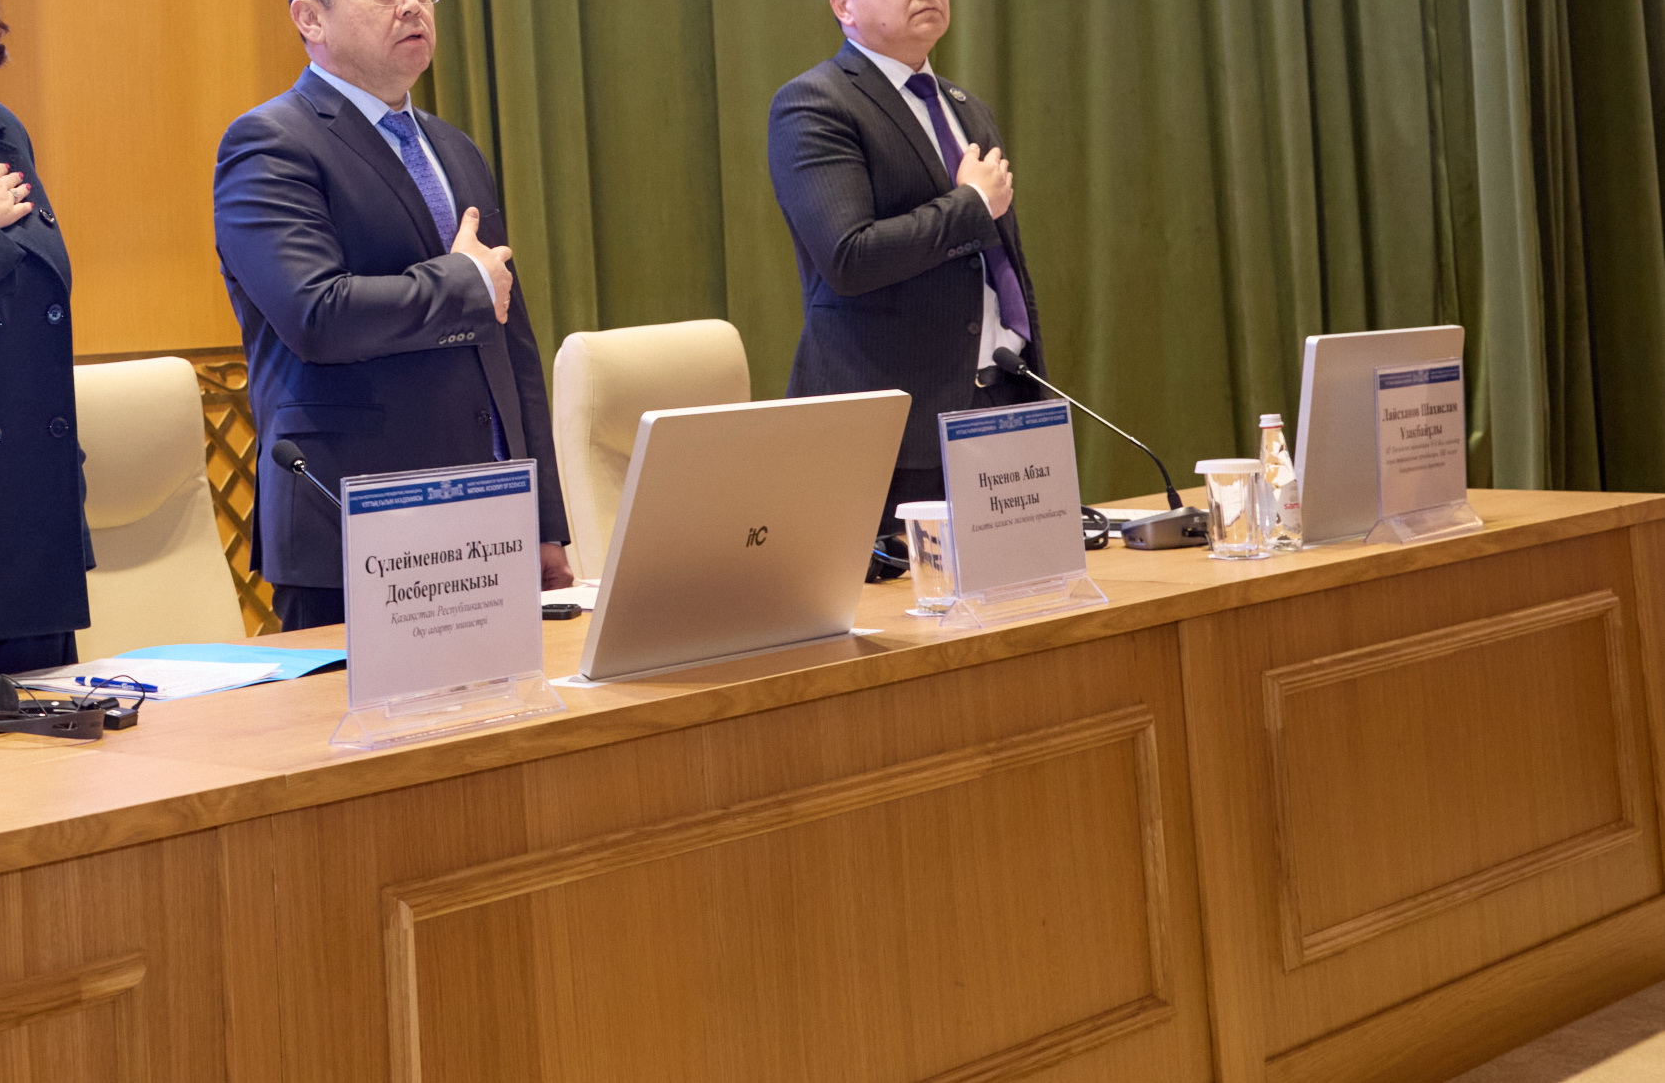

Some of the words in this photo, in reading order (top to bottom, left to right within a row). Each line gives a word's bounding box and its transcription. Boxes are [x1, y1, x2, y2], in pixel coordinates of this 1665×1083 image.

[1023, 465, 1050, 481] Абзал
[466, 539, 523, 562] Жұлдыз
[386, 573, 499, 606] Досбергенқызы
